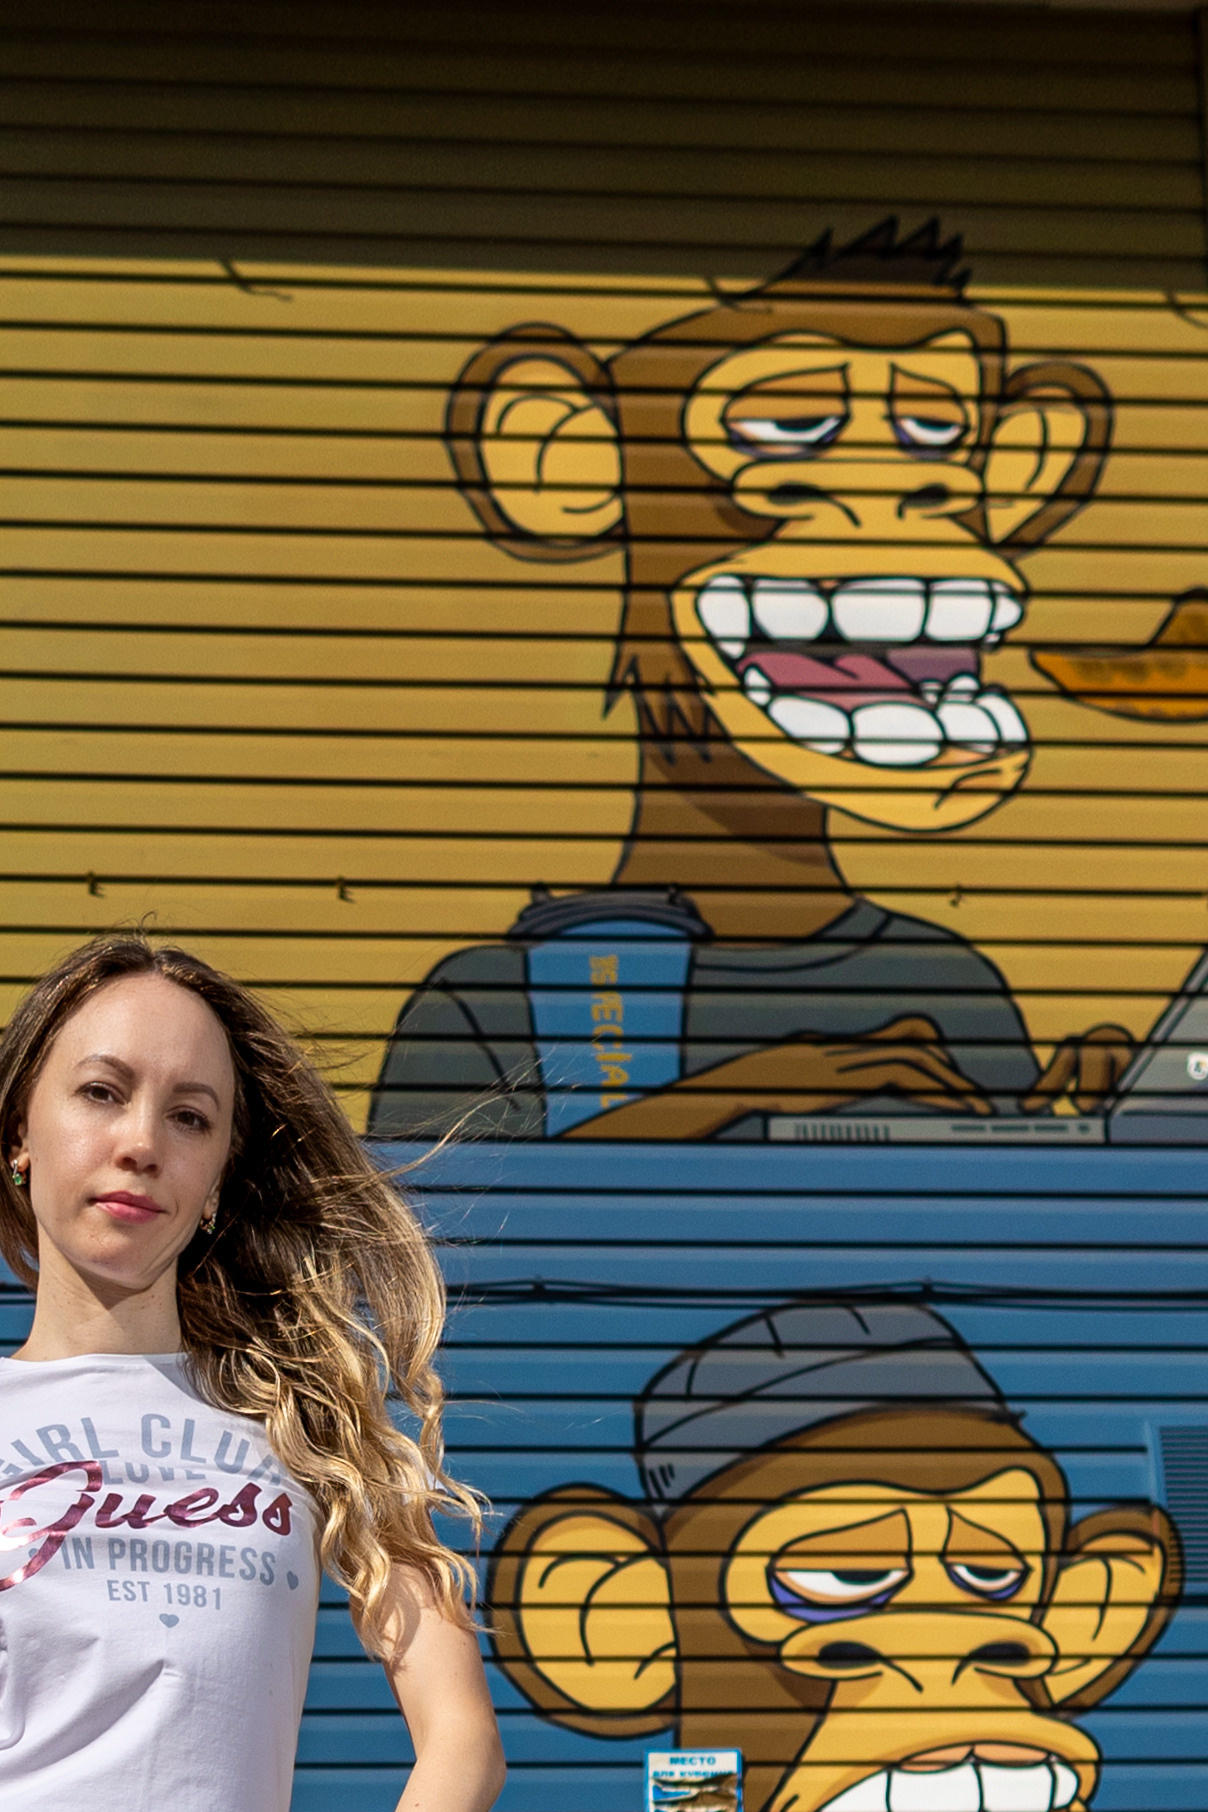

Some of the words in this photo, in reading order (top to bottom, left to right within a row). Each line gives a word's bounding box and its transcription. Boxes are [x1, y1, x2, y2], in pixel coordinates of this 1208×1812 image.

[60, 1537, 95, 1570] IN
[107, 1537, 277, 1586] PROGRESS
[106, 1579, 150, 1602] EST
[163, 1582, 222, 1611] 1981
[669, 1756, 717, 1766] МЕСТО
